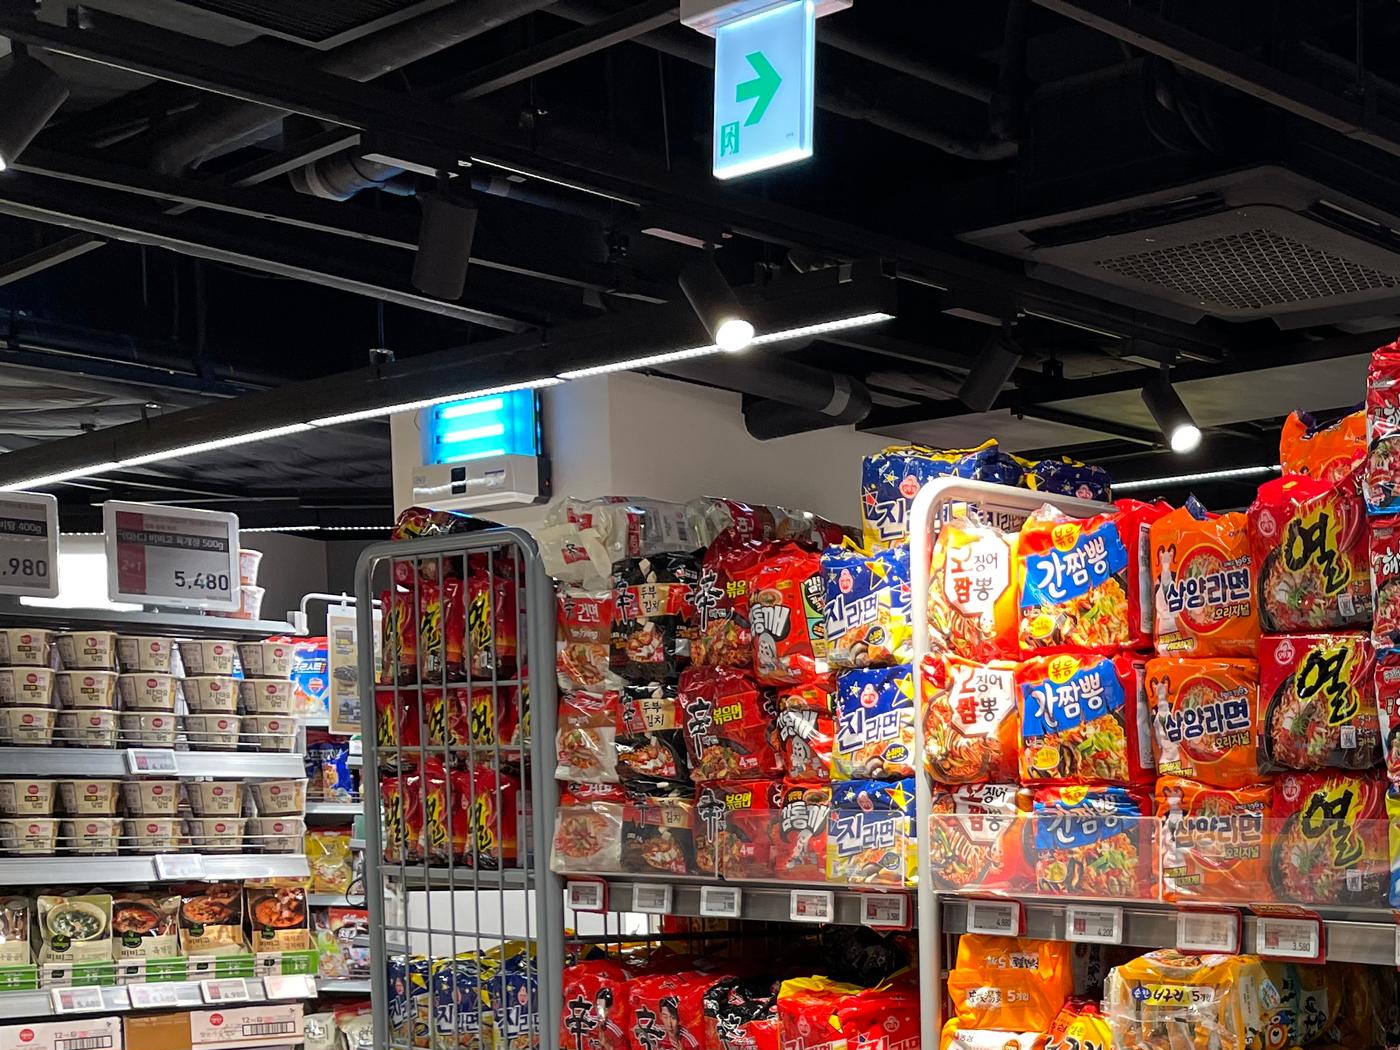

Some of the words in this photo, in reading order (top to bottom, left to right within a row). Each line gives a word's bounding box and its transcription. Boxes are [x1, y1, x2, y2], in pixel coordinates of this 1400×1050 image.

[174, 570, 229, 591] 5.480
[1036, 535, 1107, 601] 간짬뽕
[954, 575, 994, 603] 짬뽕
[1166, 576, 1251, 613] 삼양라면
[824, 593, 880, 641] 진라면
[1213, 604, 1251, 621] 오리지널
[713, 702, 743, 725] 볶음면
[956, 696, 1001, 725] 짬뽕
[1034, 671, 1105, 731] 간짬뽕
[838, 707, 901, 754] 진라면
[1165, 700, 1251, 743] 삼양라면
[1213, 732, 1251, 749] 오리지널
[726, 791, 752, 810] 볶음면
[837, 812, 897, 856] 진라면
[1176, 816, 1262, 849] 삼양라면
